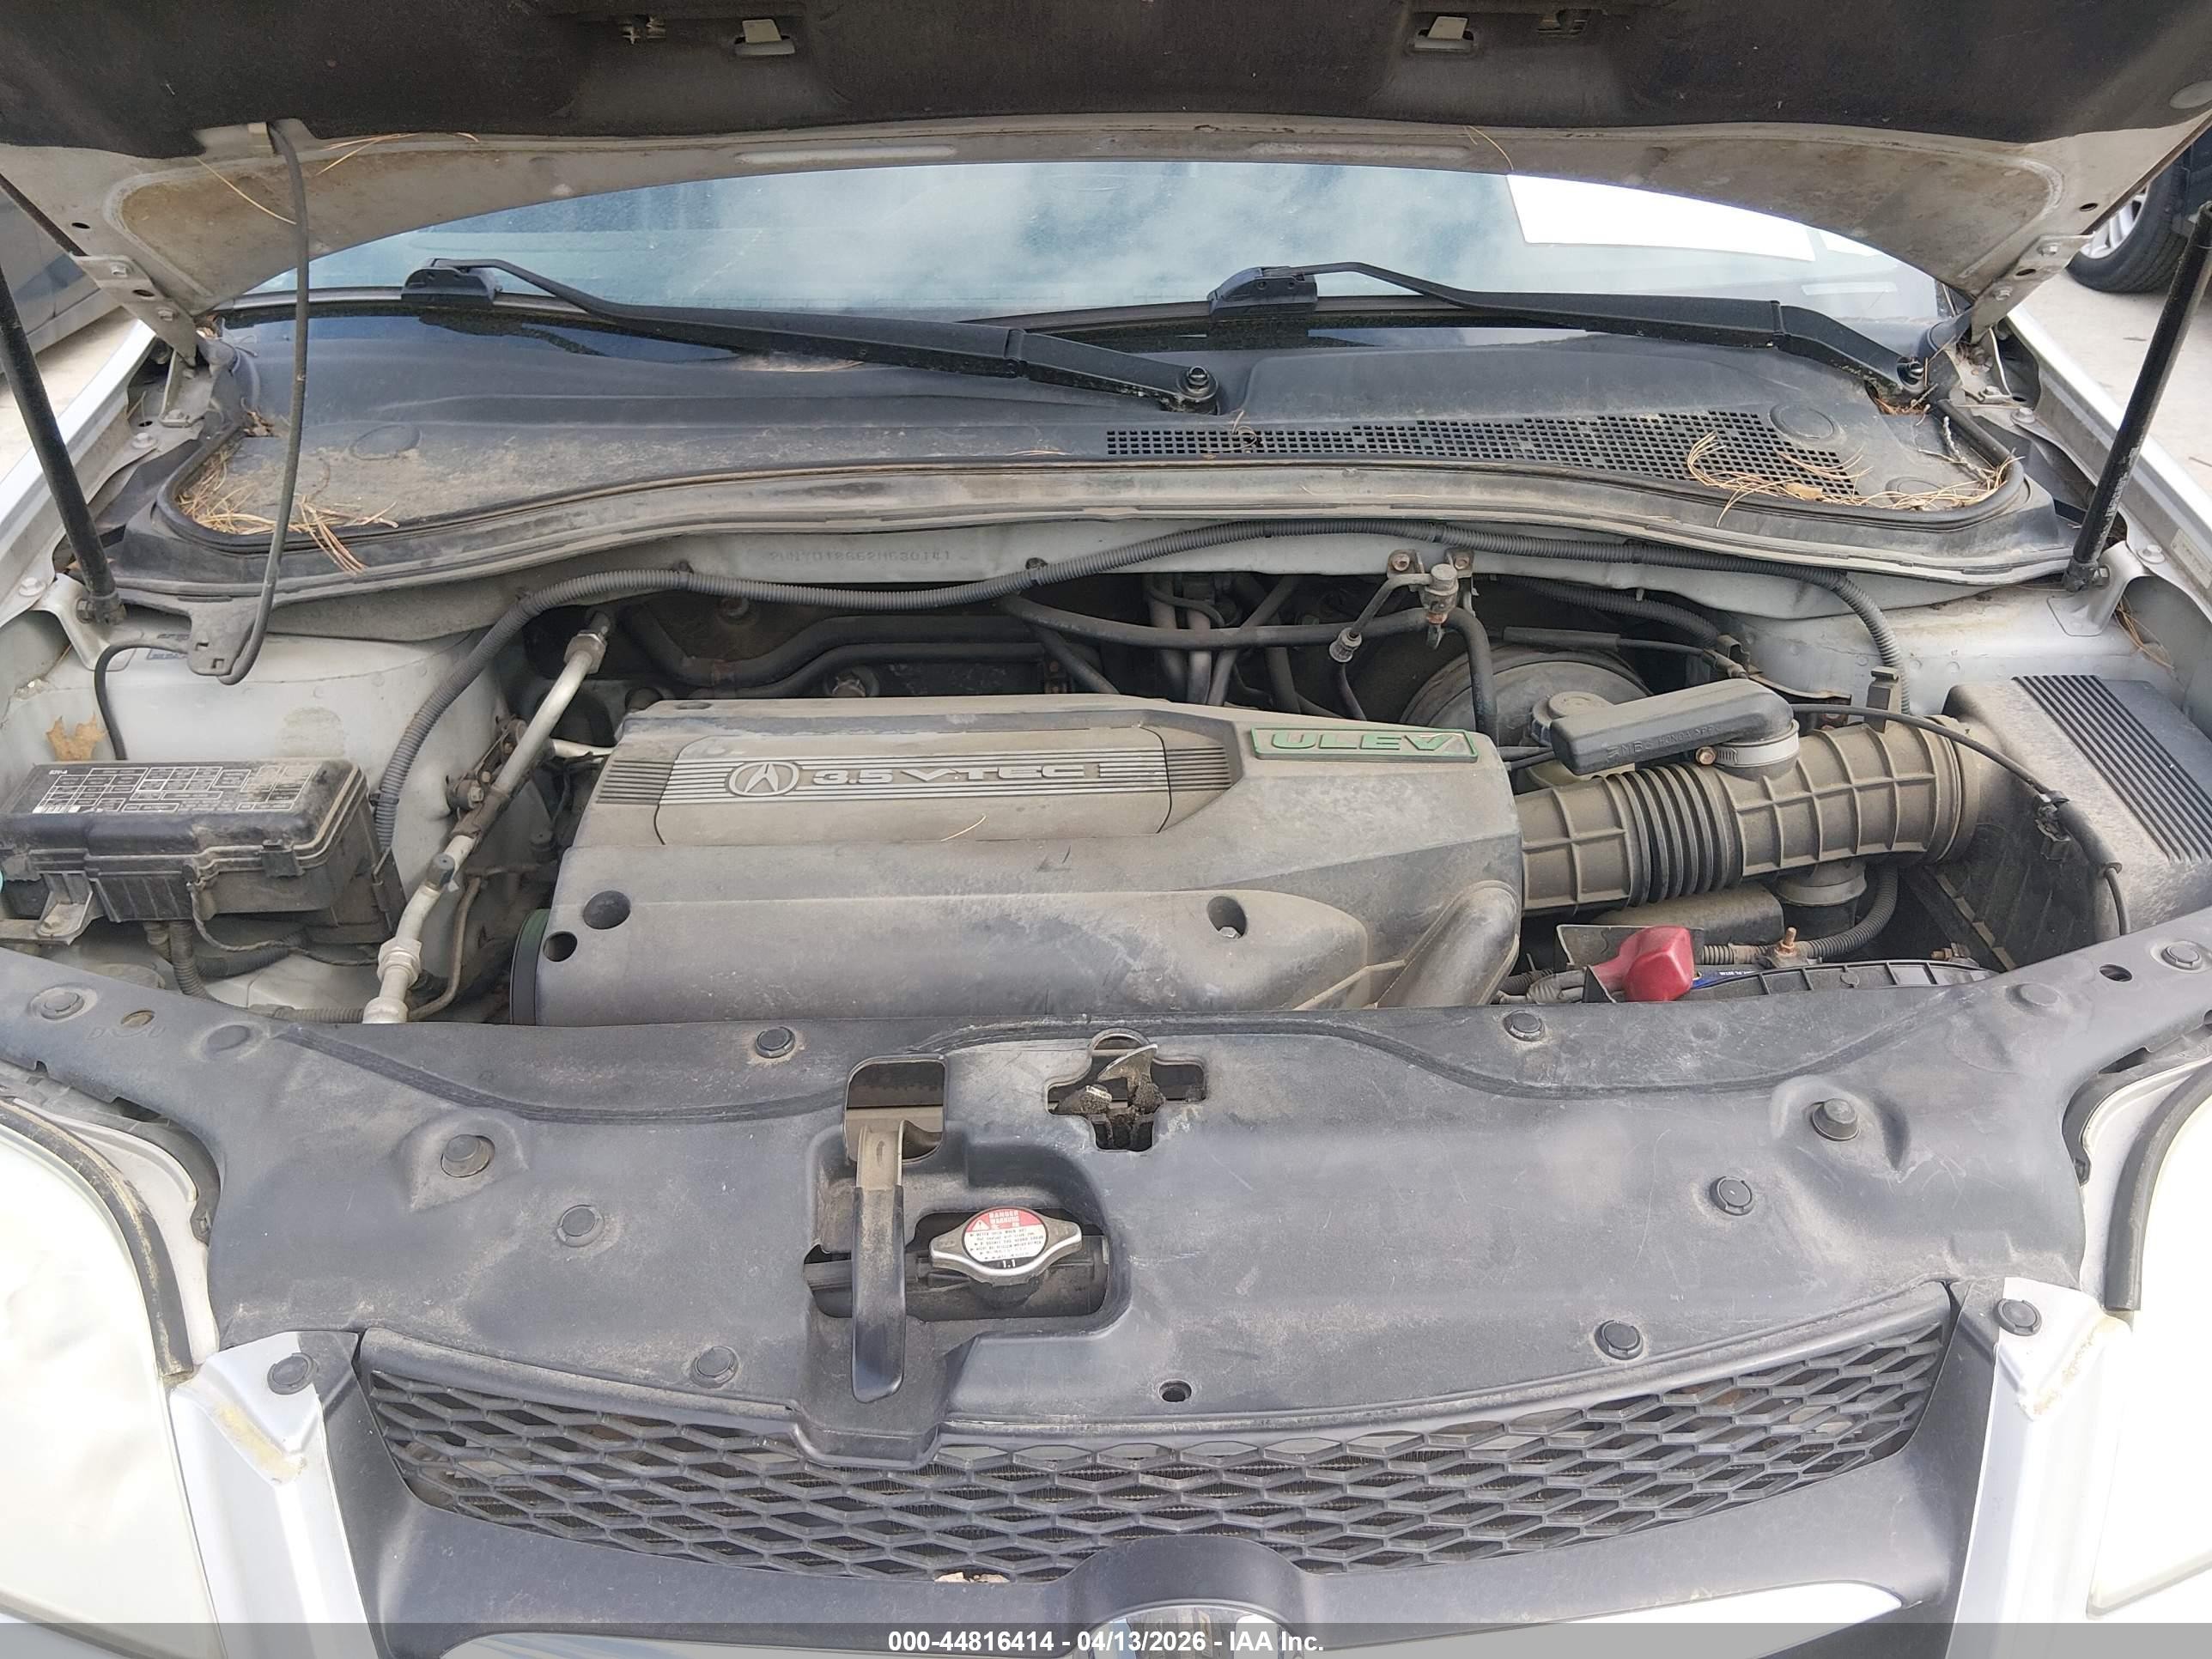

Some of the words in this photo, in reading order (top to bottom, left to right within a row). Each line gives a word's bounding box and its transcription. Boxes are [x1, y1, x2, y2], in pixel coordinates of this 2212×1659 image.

[1271, 732, 1455, 752] ULEV
[812, 769, 894, 786] 3.5
[900, 764, 1085, 782] VTEC
[1002, 1259, 1016, 1268] 1.1
